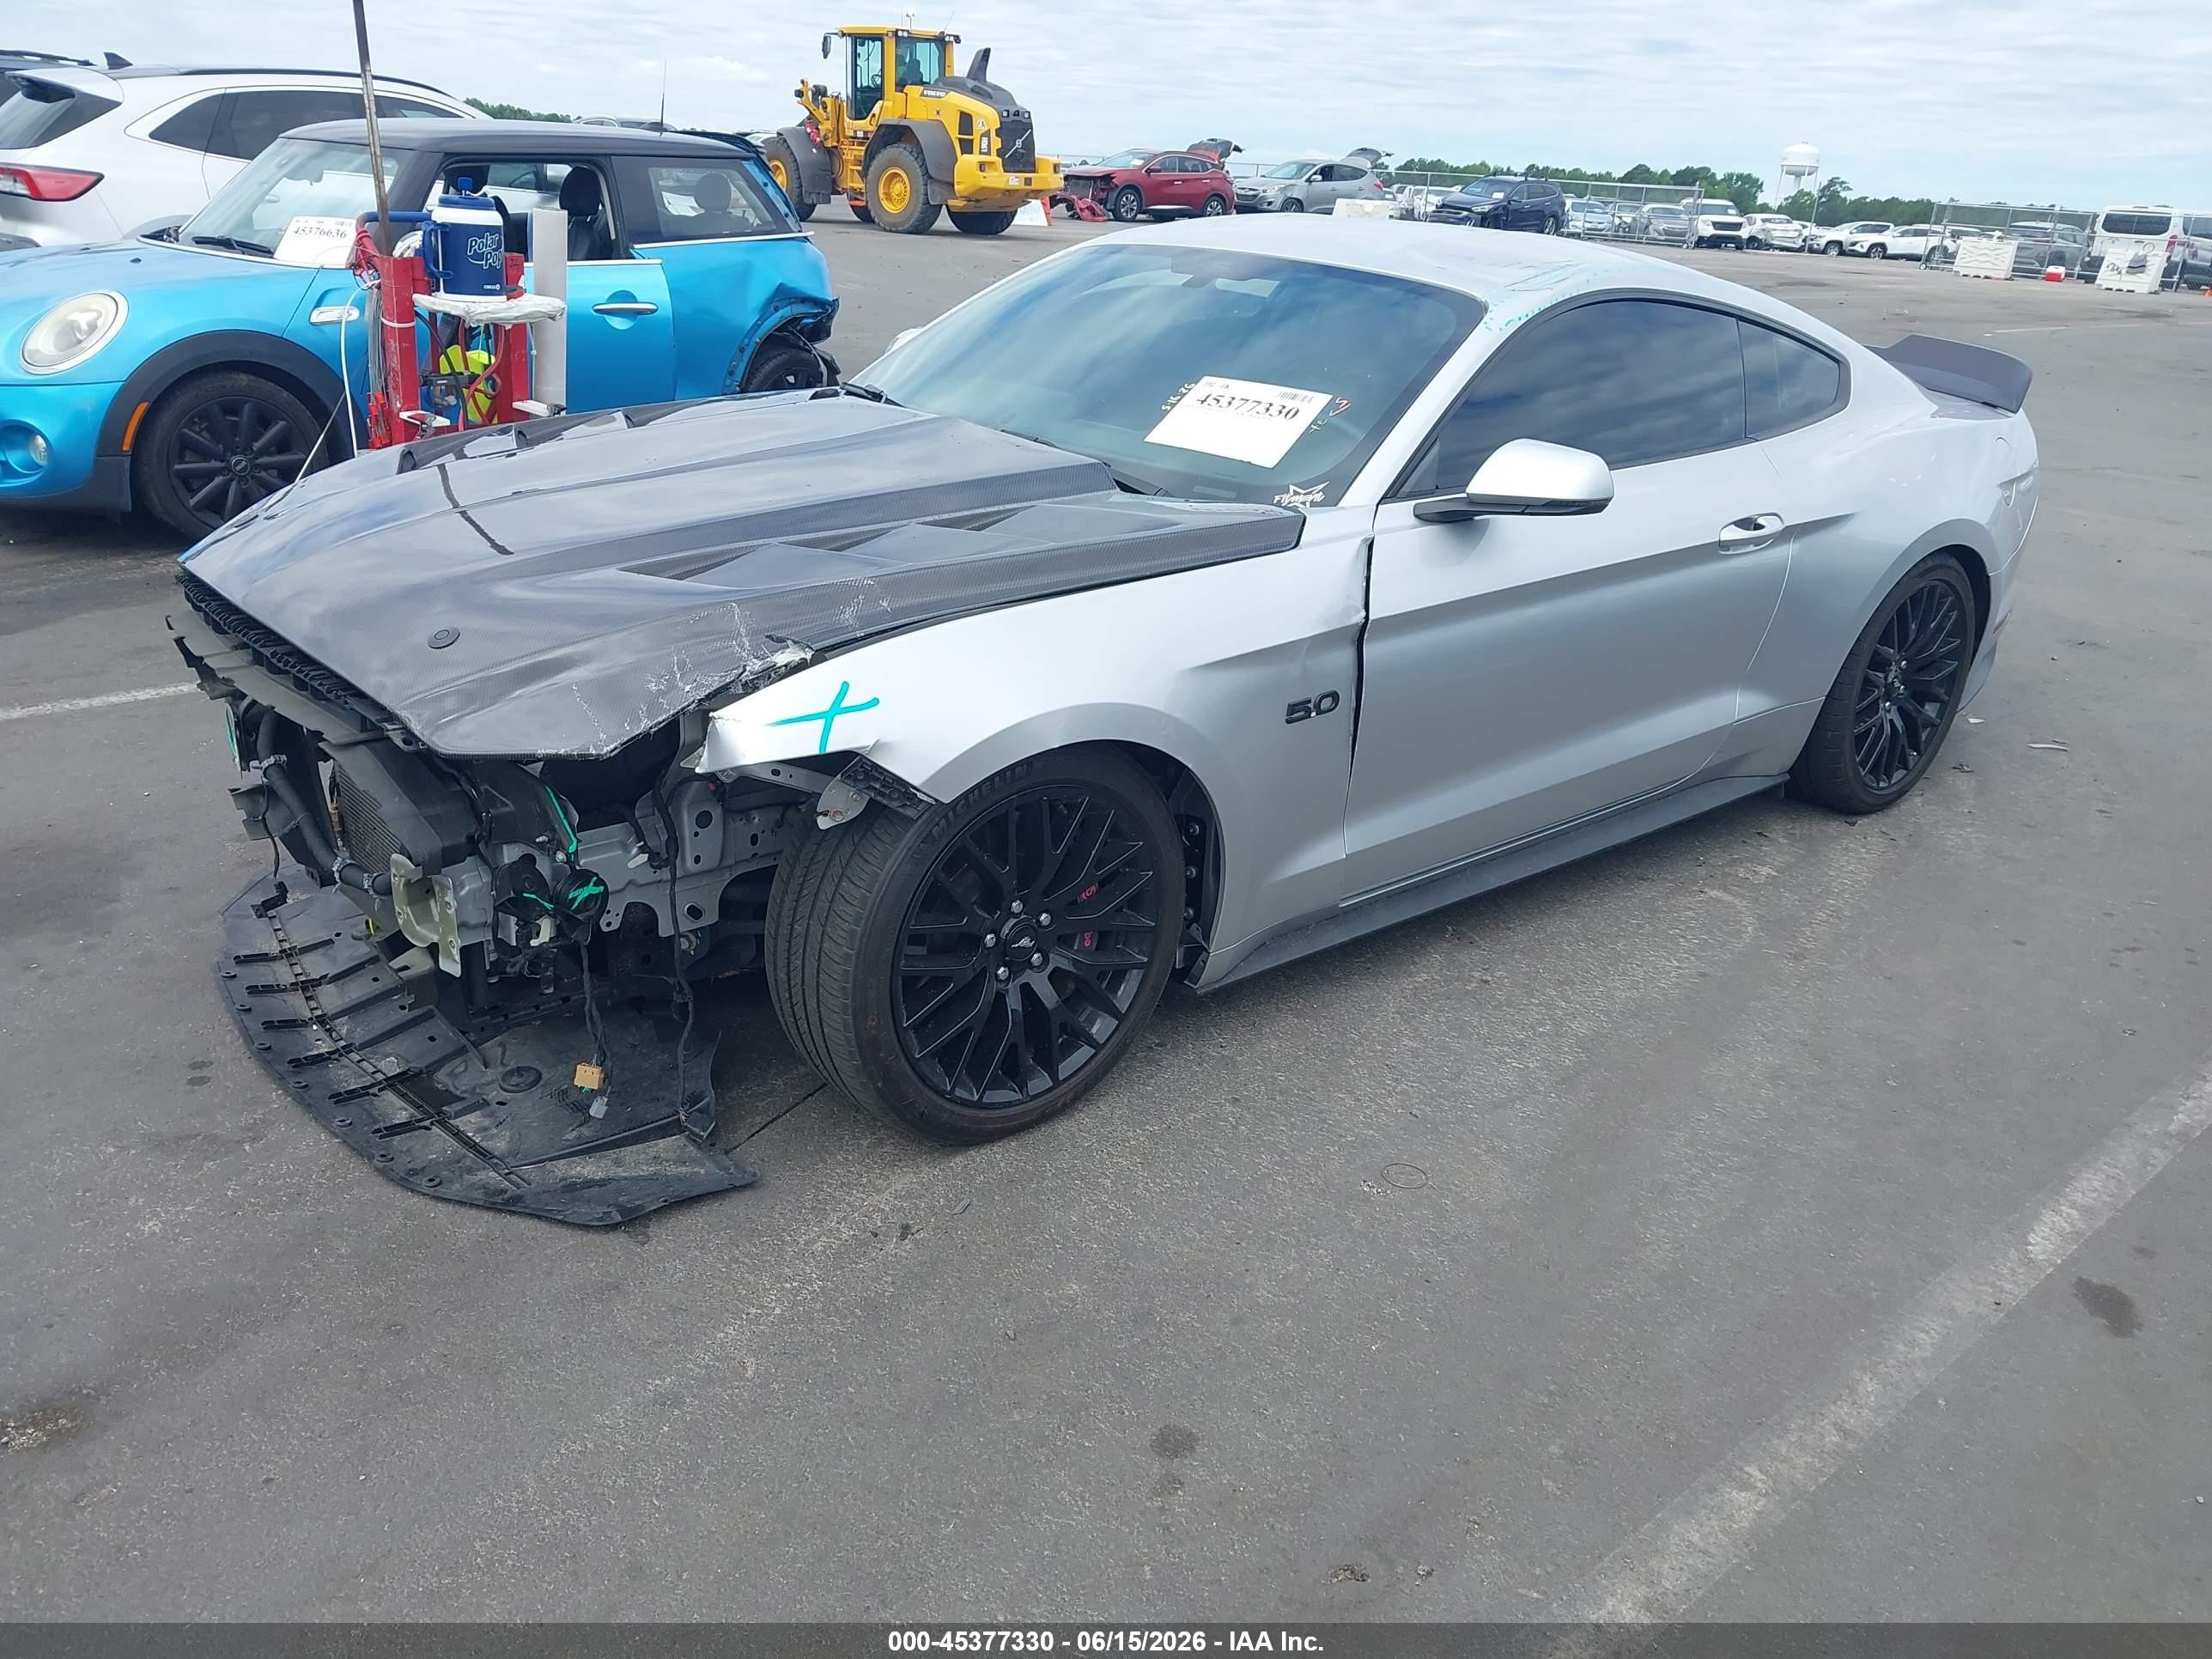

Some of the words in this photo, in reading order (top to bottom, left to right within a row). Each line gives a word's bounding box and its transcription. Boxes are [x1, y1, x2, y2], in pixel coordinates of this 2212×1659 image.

[293, 227, 347, 239] 45376636
[467, 232, 500, 256] Polar
[1195, 392, 1301, 421] 45377330
[1285, 690, 1340, 725] 5.0
[932, 763, 1030, 839] MICHELIN
